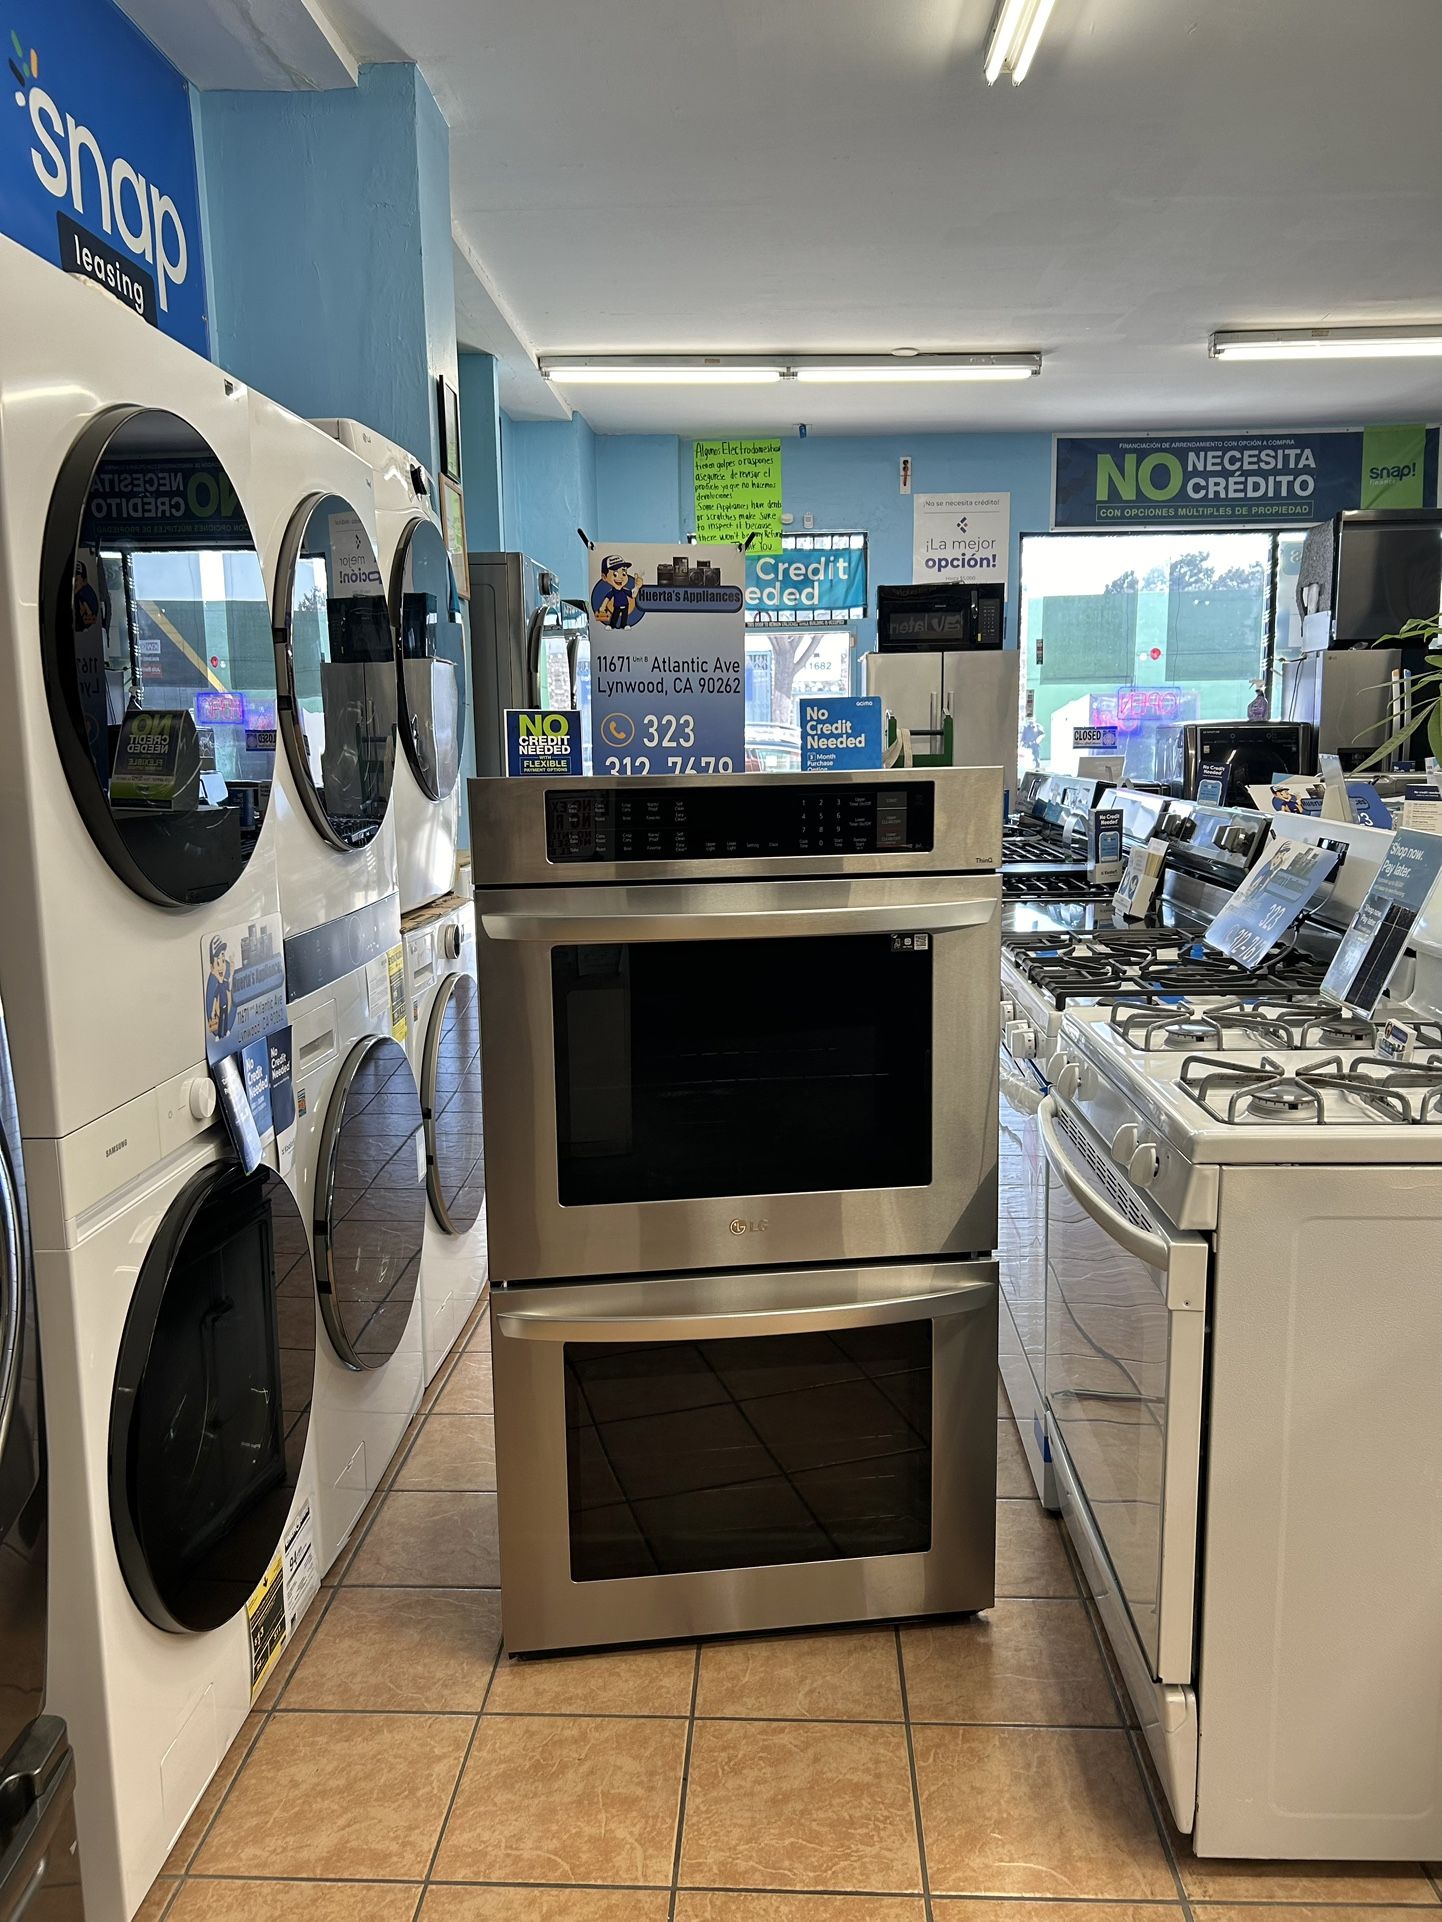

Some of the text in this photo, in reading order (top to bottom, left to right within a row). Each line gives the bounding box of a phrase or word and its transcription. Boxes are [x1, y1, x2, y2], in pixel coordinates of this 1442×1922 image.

[29, 86, 189, 313] snap
[73, 234, 146, 315] leasing
[1118, 441, 1162, 449] FINANCIACIÓN
[1238, 438, 1262, 447] OPCIÓN
[716, 459, 736, 472] golpes
[743, 457, 774, 467] raspones
[763, 467, 771, 478] el
[1369, 462, 1416, 481] snap!
[1095, 449, 1317, 501] NO NECESITA
[741, 481, 750, 489] no
[751, 479, 776, 489] hacemos
[1186, 472, 1315, 499] CRÉDITO
[696, 492, 733, 501] devoluciones
[945, 499, 974, 507] necesita
[974, 499, 1000, 507] crédito!
[697, 501, 715, 511] Some
[716, 501, 749, 512] Appliances
[750, 499, 765, 509] have
[1100, 504, 1309, 517] CON OPCIONES MÚLTIPLES DE PROPIEDAD
[706, 512, 737, 521] scratches
[738, 512, 756, 521] make
[696, 523, 705, 532] to
[708, 522, 733, 531] inspect
[745, 520, 772, 530] because
[697, 533, 717, 542] there
[719, 532, 739, 541] won't
[926, 537, 996, 552] ¡La mejor
[756, 556, 849, 581] Credit
[925, 553, 997, 573] opción!
[639, 589, 741, 604] Huerta's Appliances
[744, 581, 819, 605] eded
[597, 655, 631, 673] 11671
[651, 656, 709, 673] Atlantic
[713, 656, 741, 673] Ave
[597, 677, 741, 697] Lynwood, CA 90262
[806, 706, 829, 720] No
[519, 714, 569, 737] NO
[643, 714, 695, 748] 323
[806, 719, 852, 735] Credit
[519, 735, 570, 746] CREDIT
[807, 733, 866, 749] Needed
[1073, 730, 1102, 741] CLOSED
[519, 745, 571, 755] NEEDED
[524, 760, 567, 768] FLEXIBLE
[836, 798, 841, 806] 3
[1390, 843, 1425, 861] Shop now.
[1381, 859, 1412, 878] Pay later.
[1259, 903, 1287, 932] 323
[270, 1046, 278, 1058] No
[245, 1057, 254, 1072] No
[271, 1052, 287, 1069] Credit
[247, 1064, 263, 1085] Credit
[271, 1060, 291, 1080] Needed
[248, 1074, 270, 1099] Needed
[105, 1138, 127, 1158] SAMSUNG
